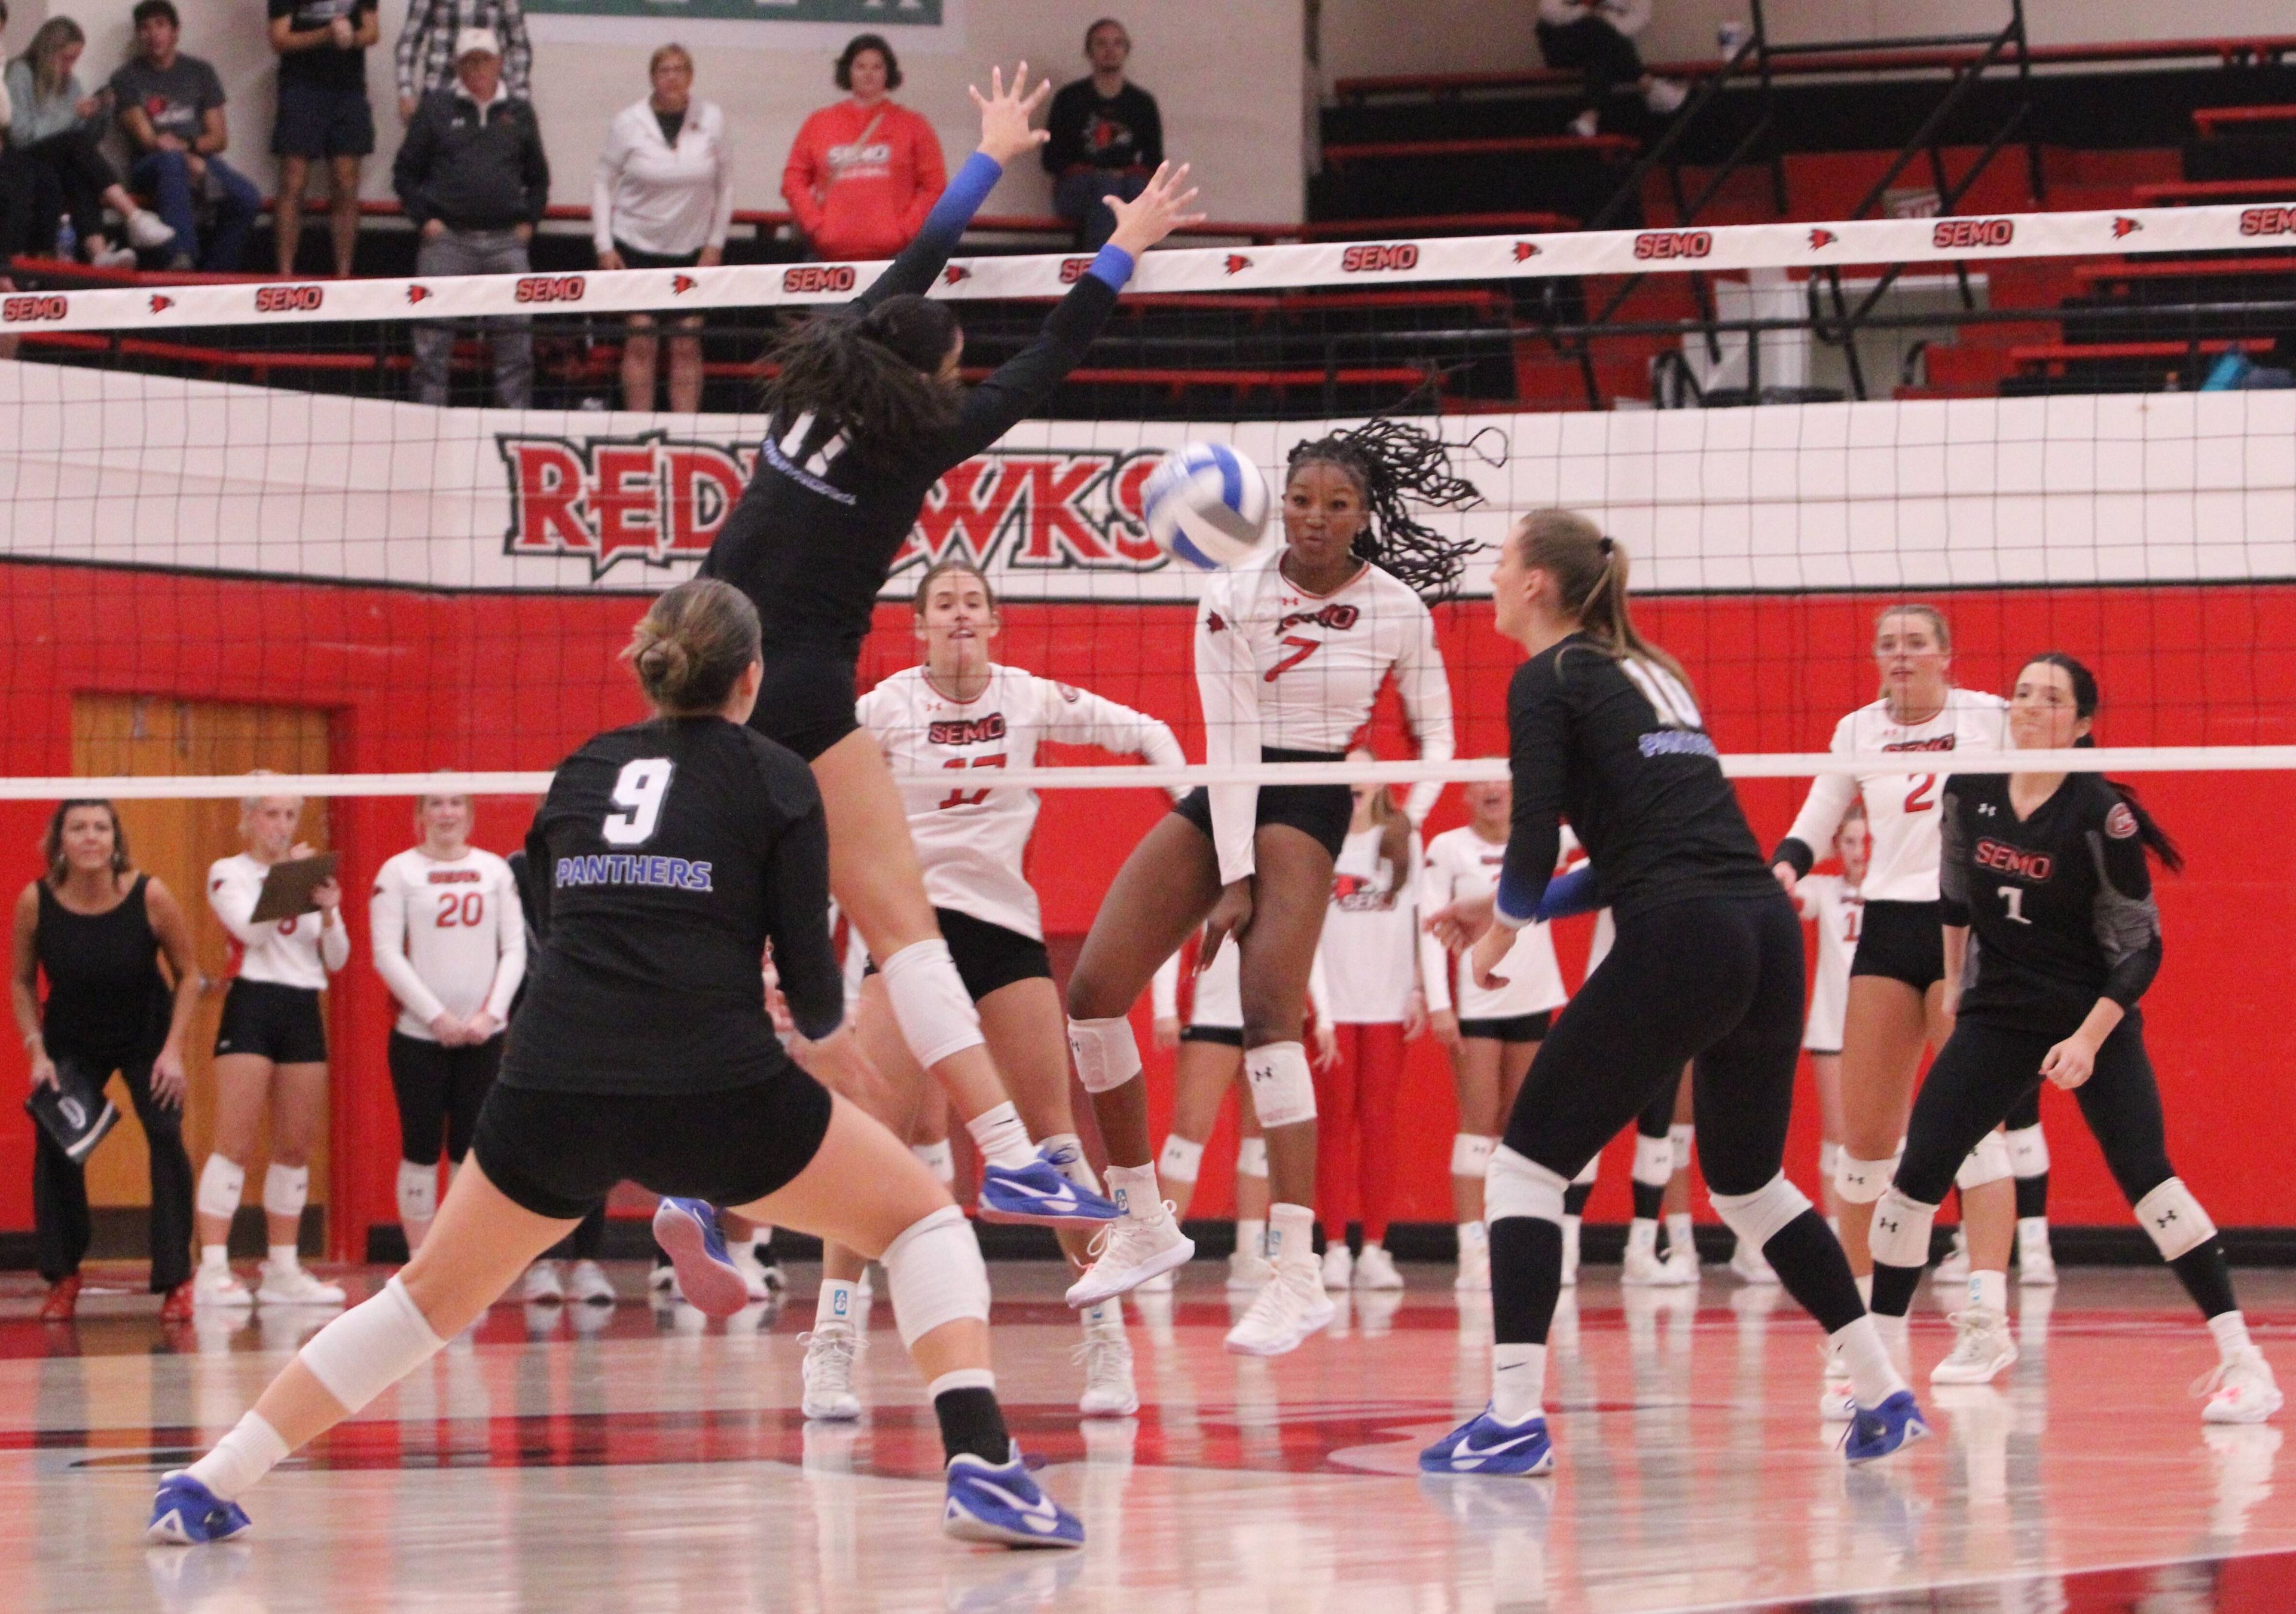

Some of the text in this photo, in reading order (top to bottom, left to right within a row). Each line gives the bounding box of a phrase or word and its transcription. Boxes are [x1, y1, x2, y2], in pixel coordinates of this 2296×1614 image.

[1932, 219, 2014, 248] SEMO
[2240, 208, 2296, 236] SEM
[1342, 244, 1418, 272] SEMO
[1634, 231, 1712, 259] SEMO
[783, 266, 856, 292] SEMO
[1060, 258, 1090, 283] SE
[255, 286, 323, 312] SEMO
[514, 276, 586, 302] SEMO
[2, 296, 68, 321] SEMO
[1263, 635, 1321, 682] 7
[929, 712, 1006, 745] SEMO
[602, 757, 677, 850] 9
[1904, 773, 1937, 813] 2
[555, 855, 713, 891] PANTHERS
[1974, 839, 2053, 881] SEMO
[435, 891, 484, 928] 20
[1997, 886, 2032, 924] 1
